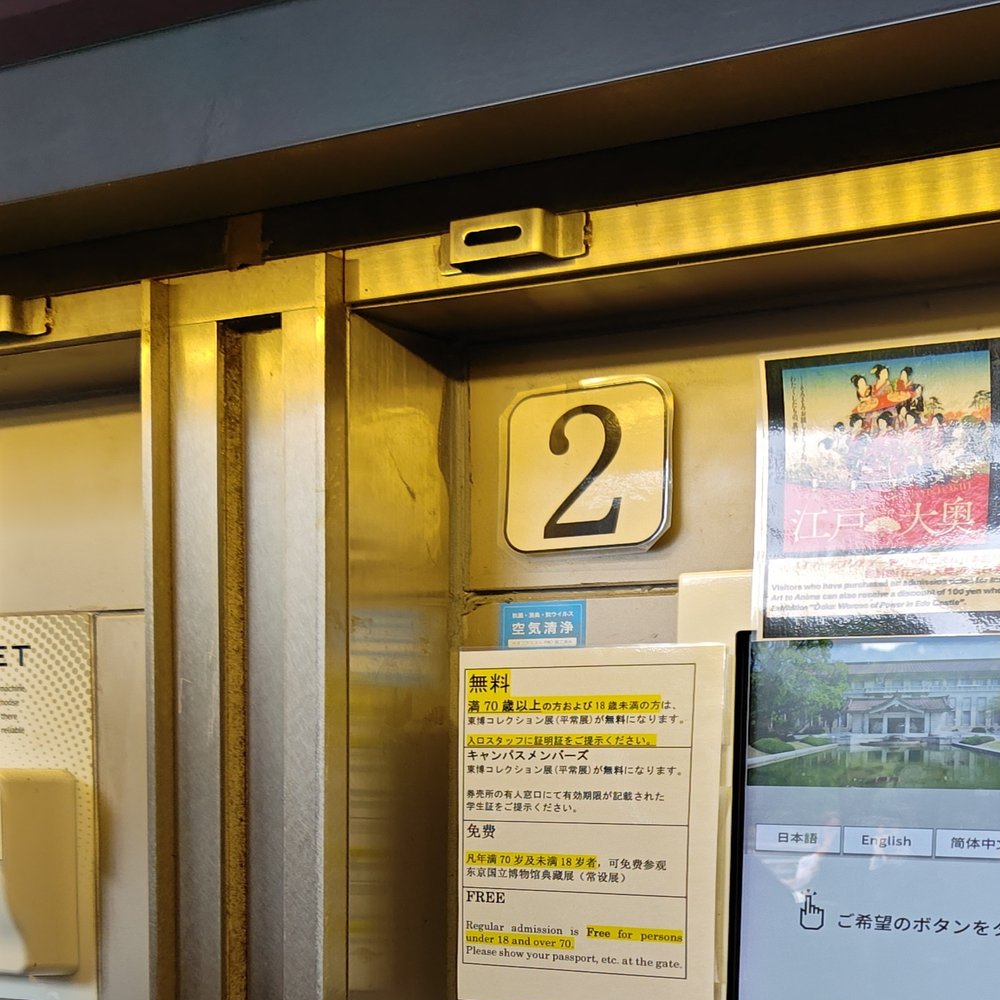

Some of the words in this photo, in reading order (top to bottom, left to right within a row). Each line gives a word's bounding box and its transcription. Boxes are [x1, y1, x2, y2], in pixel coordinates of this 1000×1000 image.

[544, 404, 622, 539] 2
[792, 506, 865, 542] 江戸
[901, 497, 974, 538] 大奥
[966, 588, 982, 596] yen
[512, 621, 574, 635] 空気清浄
[469, 673, 510, 693] 無料
[468, 736, 650, 746] 入口スタッフに証明証をご提示ください。
[466, 790, 664, 801] 券売所の有人窓口にて有効期限が記載された
[466, 802, 577, 813] 学生証をご提示ください。
[467, 824, 496, 838] 免费
[778, 832, 817, 844] 日本語
[862, 834, 912, 847] English
[466, 890, 505, 904] FREE
[466, 920, 504, 931] Regular
[511, 924, 563, 935] admission
[570, 927, 579, 935] is
[587, 927, 610, 937] Free
[618, 929, 633, 939] for
[640, 933, 683, 943] persons
[466, 935, 494, 943] under
[498, 936, 509, 945] 18
[512, 937, 530, 946] and
[534, 939, 556, 947] over
[560, 939, 574, 949] 70.
[466, 946, 497, 956] Please
[499, 948, 523, 958] show
[526, 952, 550, 961] your
[552, 953, 599, 964] passport,
[601, 956, 620, 965] etc.
[622, 957, 633, 965] at
[636, 957, 653, 967] the
[656, 960, 683, 969] gate.
